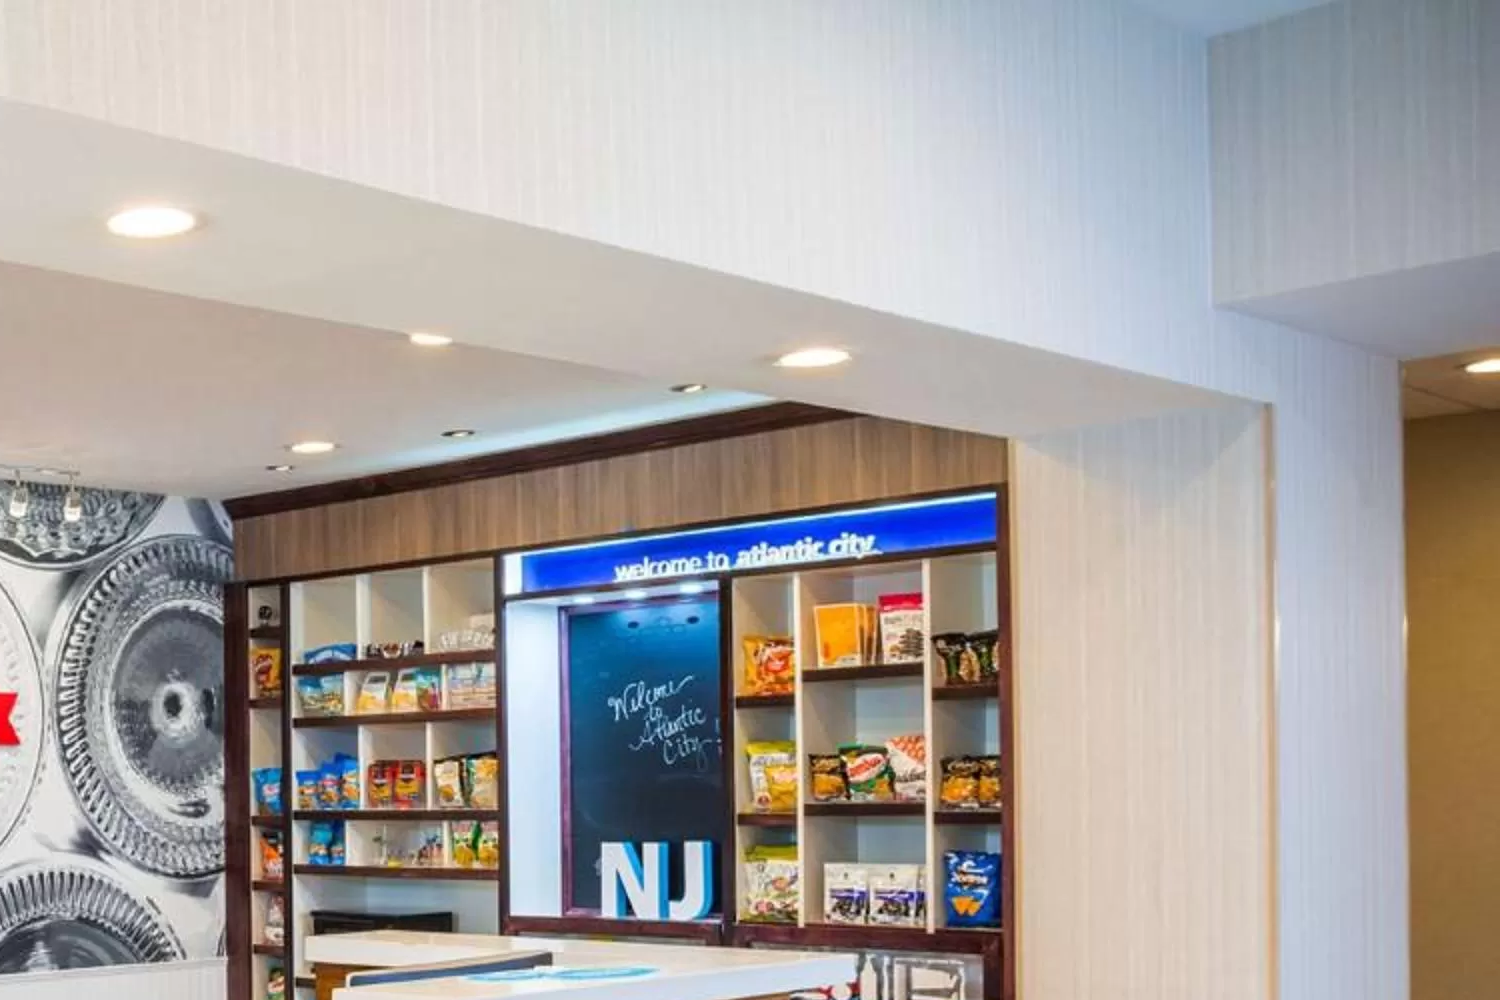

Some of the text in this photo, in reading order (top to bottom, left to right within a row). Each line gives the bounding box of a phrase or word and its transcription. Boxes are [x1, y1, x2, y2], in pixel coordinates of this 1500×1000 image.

[612, 555, 701, 583] welcome
[707, 550, 730, 570] to
[736, 536, 823, 567] atlantic
[607, 675, 694, 722] Welcome
[649, 703, 664, 722] to
[628, 704, 707, 751] Atlantic
[601, 840, 713, 920] NJ
